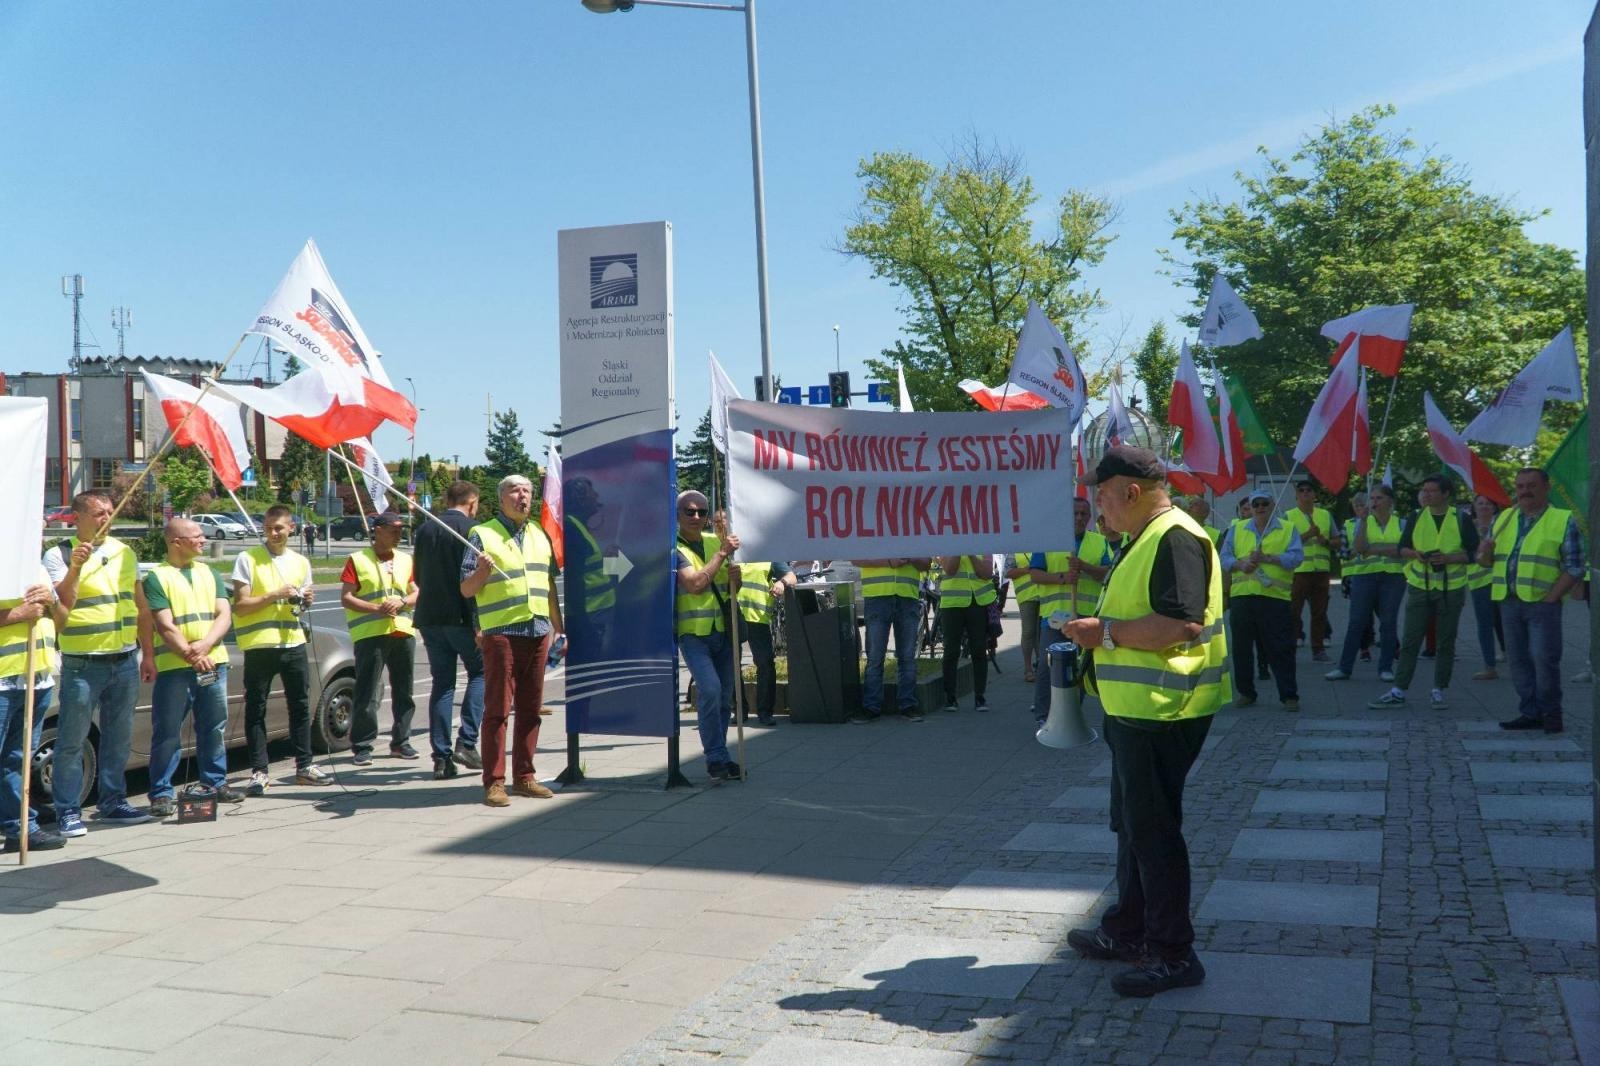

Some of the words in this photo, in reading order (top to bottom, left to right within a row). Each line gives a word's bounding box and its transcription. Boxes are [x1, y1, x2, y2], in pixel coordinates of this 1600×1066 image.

[567, 318, 598, 329] Agencja
[601, 312, 665, 325] Restrukturyzacji
[572, 330, 622, 341] Modernizacji
[625, 327, 664, 337] Rolnictwa
[602, 359, 628, 371] Śląski
[598, 372, 632, 383] Oddział
[1019, 371, 1050, 391] REGION
[591, 387, 639, 399] Regionalny
[753, 429, 796, 471] MY
[804, 428, 931, 472] RÓWNIEŻ
[936, 427, 1061, 472] JESTEŚMY
[805, 484, 1000, 539] ROLNIKAMI
